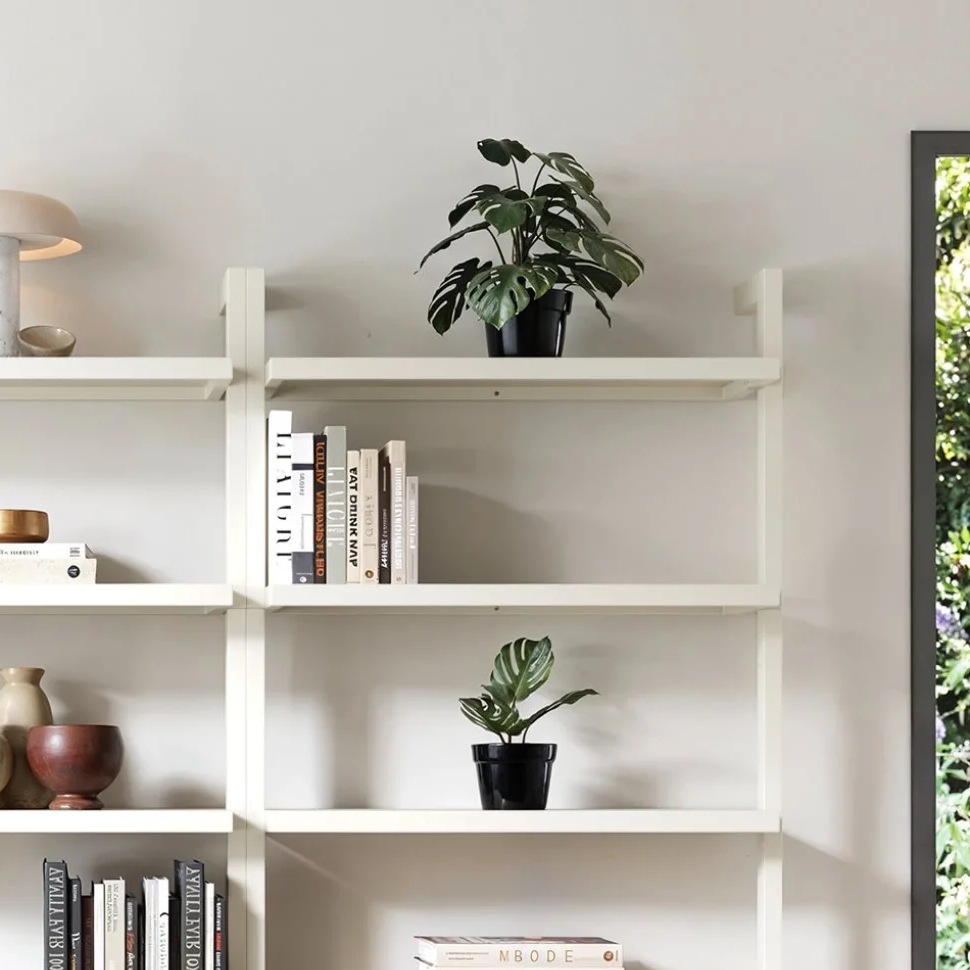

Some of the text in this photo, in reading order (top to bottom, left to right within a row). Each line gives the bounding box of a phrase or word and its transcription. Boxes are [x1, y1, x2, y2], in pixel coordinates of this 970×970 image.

[349, 467, 358, 567] EAT DRINK NAP
